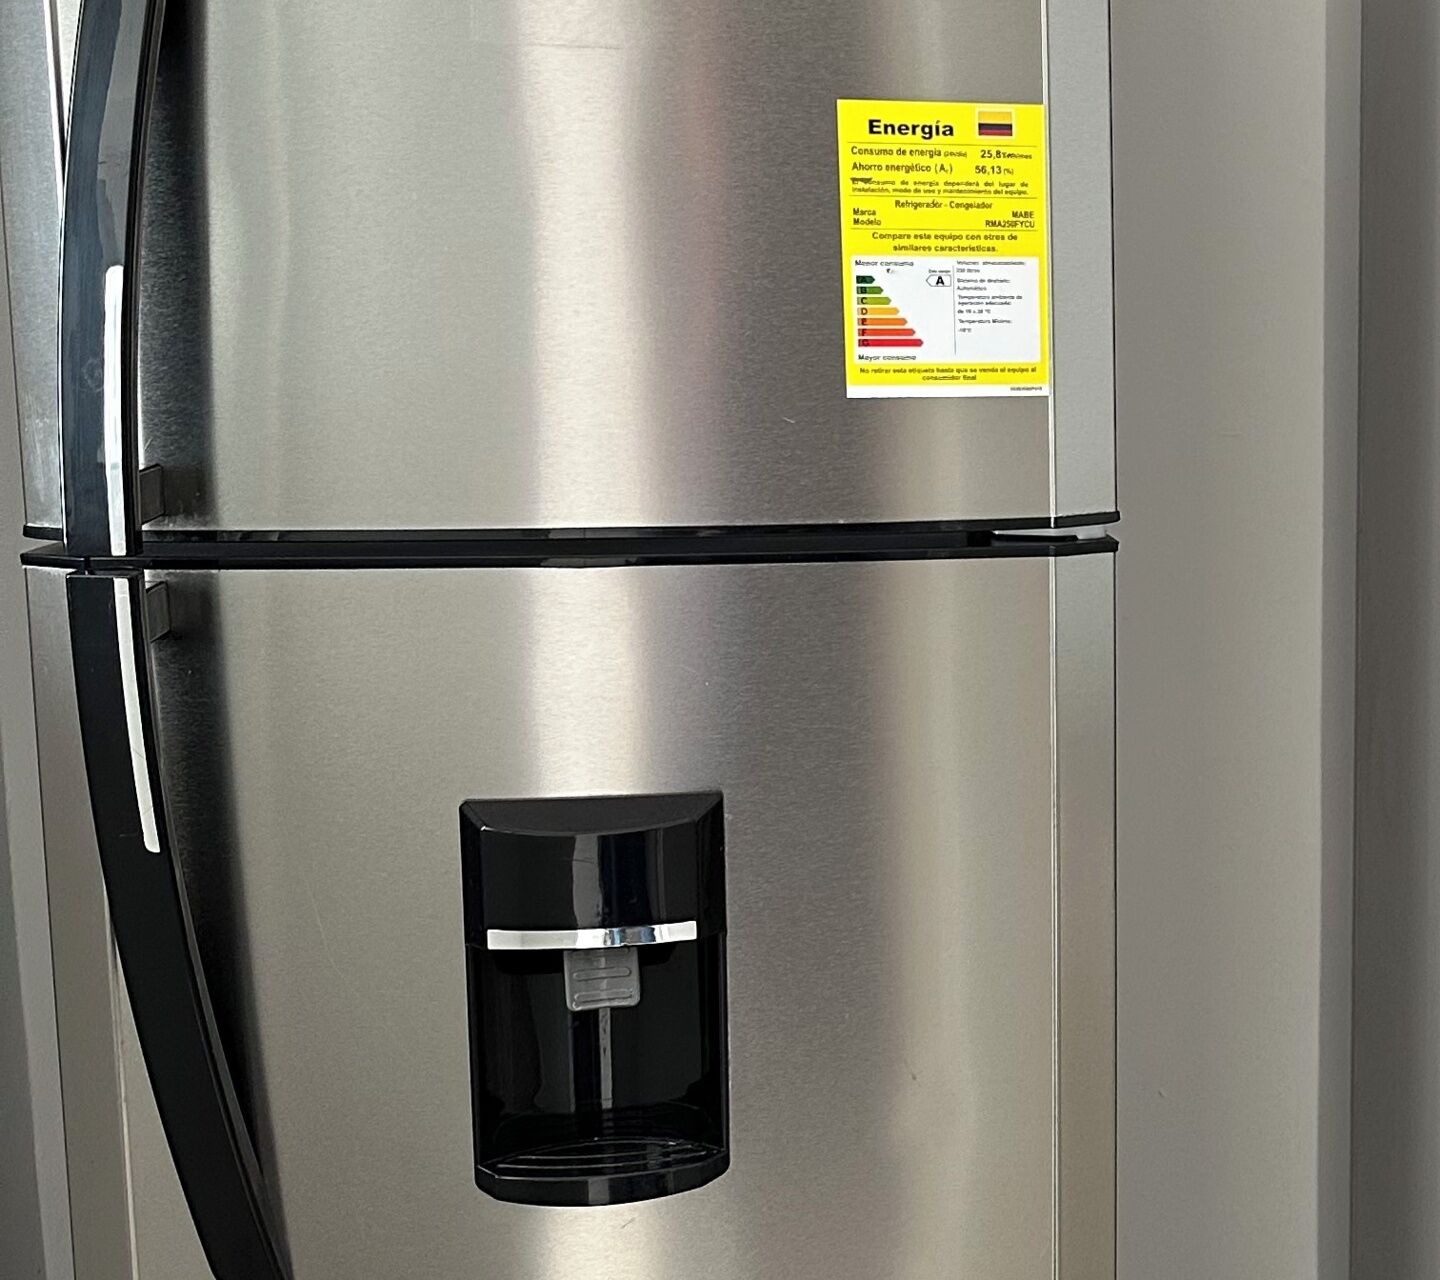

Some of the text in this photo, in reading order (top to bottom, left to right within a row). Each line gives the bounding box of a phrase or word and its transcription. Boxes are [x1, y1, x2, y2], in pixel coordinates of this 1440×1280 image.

[868, 119, 954, 140] Energía
[851, 146, 893, 155] Consumo
[896, 147, 907, 156] de
[909, 148, 942, 159] energía
[852, 162, 883, 171] Ahorro
[885, 162, 931, 174] energético
[975, 166, 1001, 175] 56,13
[895, 200, 942, 210] Refrigerador
[950, 201, 992, 210] Congelador
[872, 232, 911, 241] Compare
[934, 233, 963, 242] equipo
[936, 276, 944, 285] A
